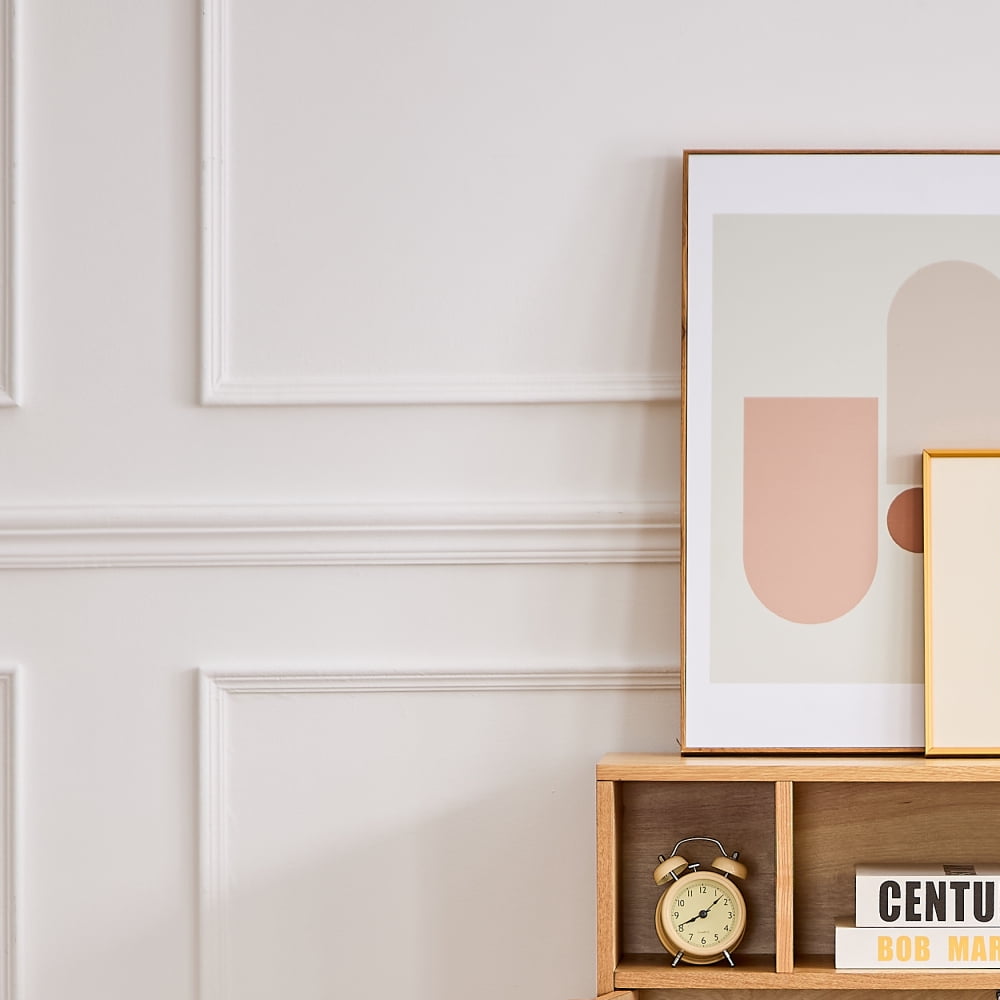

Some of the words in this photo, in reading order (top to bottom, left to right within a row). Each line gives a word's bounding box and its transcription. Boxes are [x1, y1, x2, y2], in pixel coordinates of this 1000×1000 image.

[687, 889, 693, 897] 11
[699, 886, 707, 894] 12
[723, 898, 729, 906] 2
[877, 936, 931, 962] BOB
